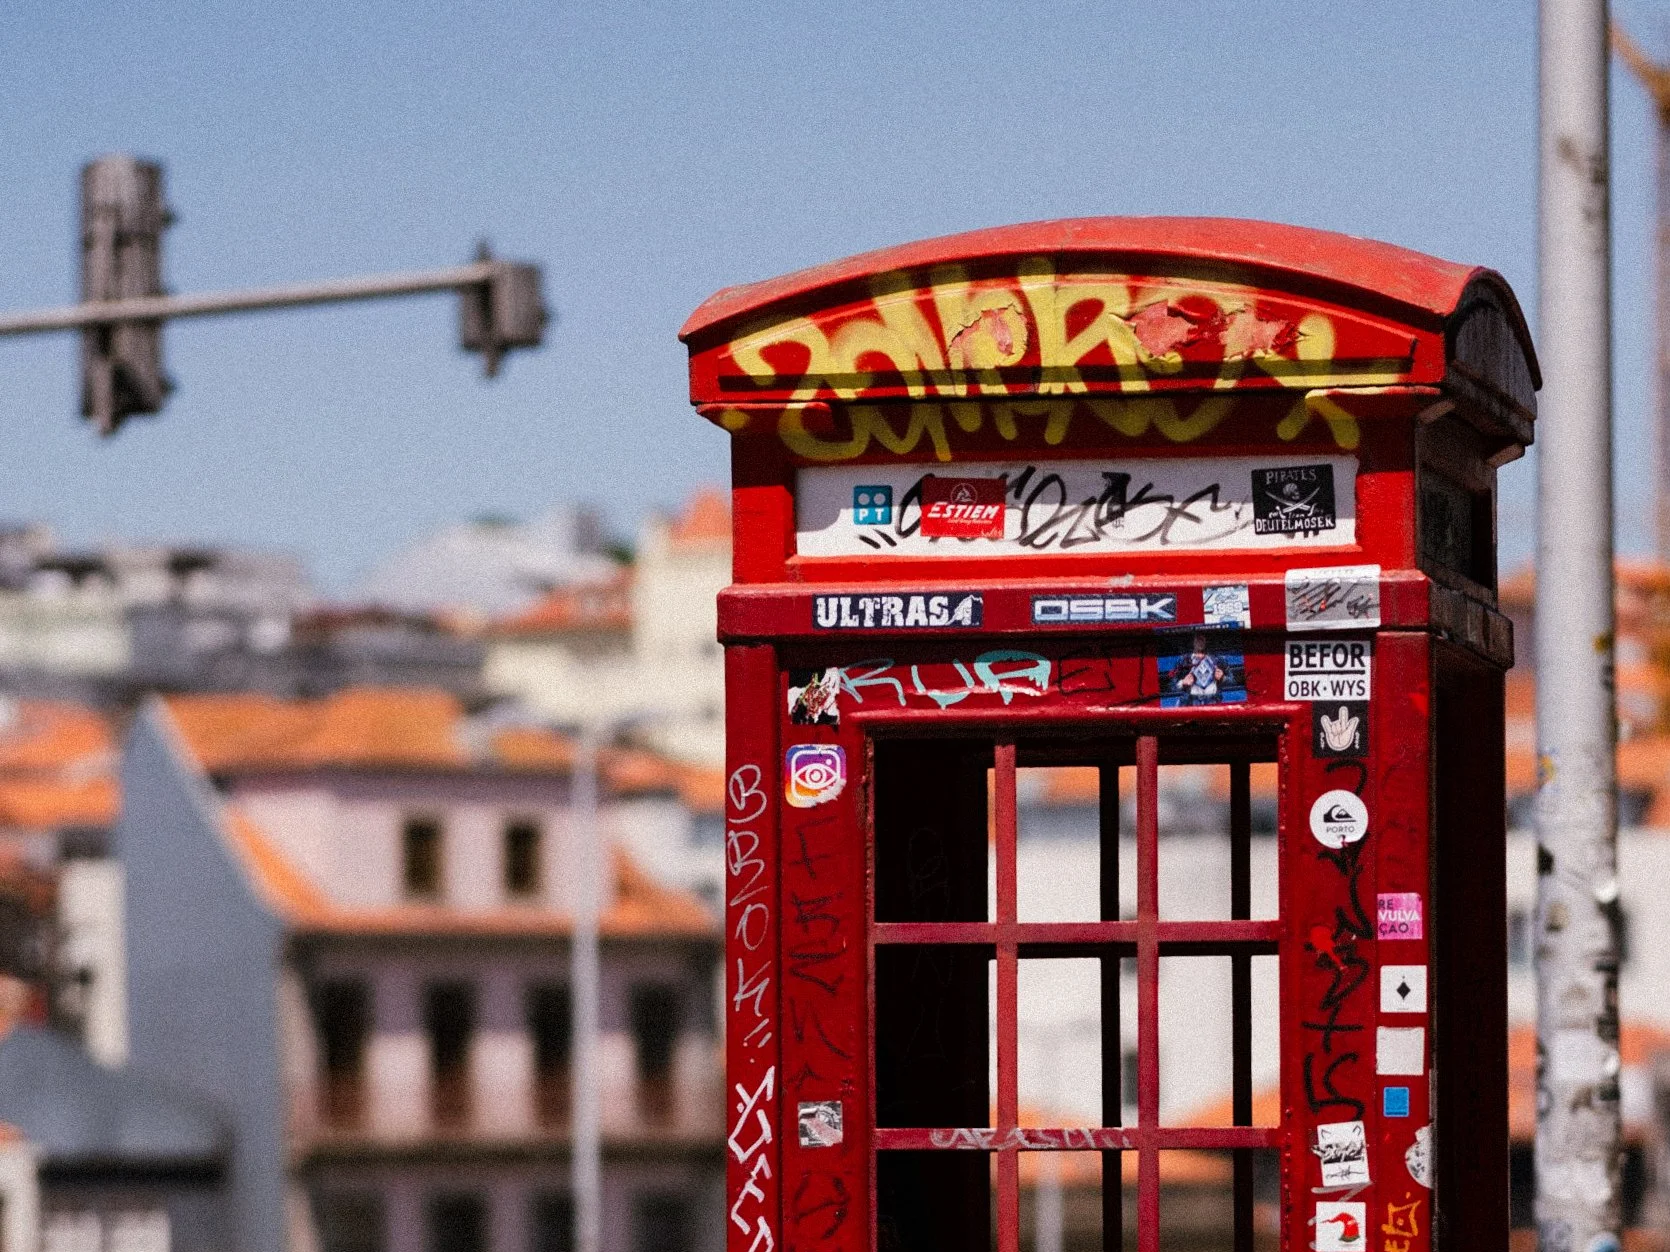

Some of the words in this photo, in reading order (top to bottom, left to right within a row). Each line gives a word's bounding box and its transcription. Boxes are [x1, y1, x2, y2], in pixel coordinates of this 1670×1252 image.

[927, 501, 1001, 519] ESTIEM
[1035, 598, 1175, 621] OSBK
[1288, 643, 1366, 669] BEFOR
[1326, 825, 1355, 833] PORTO
[1378, 898, 1394, 910] RE
[1378, 909, 1421, 922] VULVA
